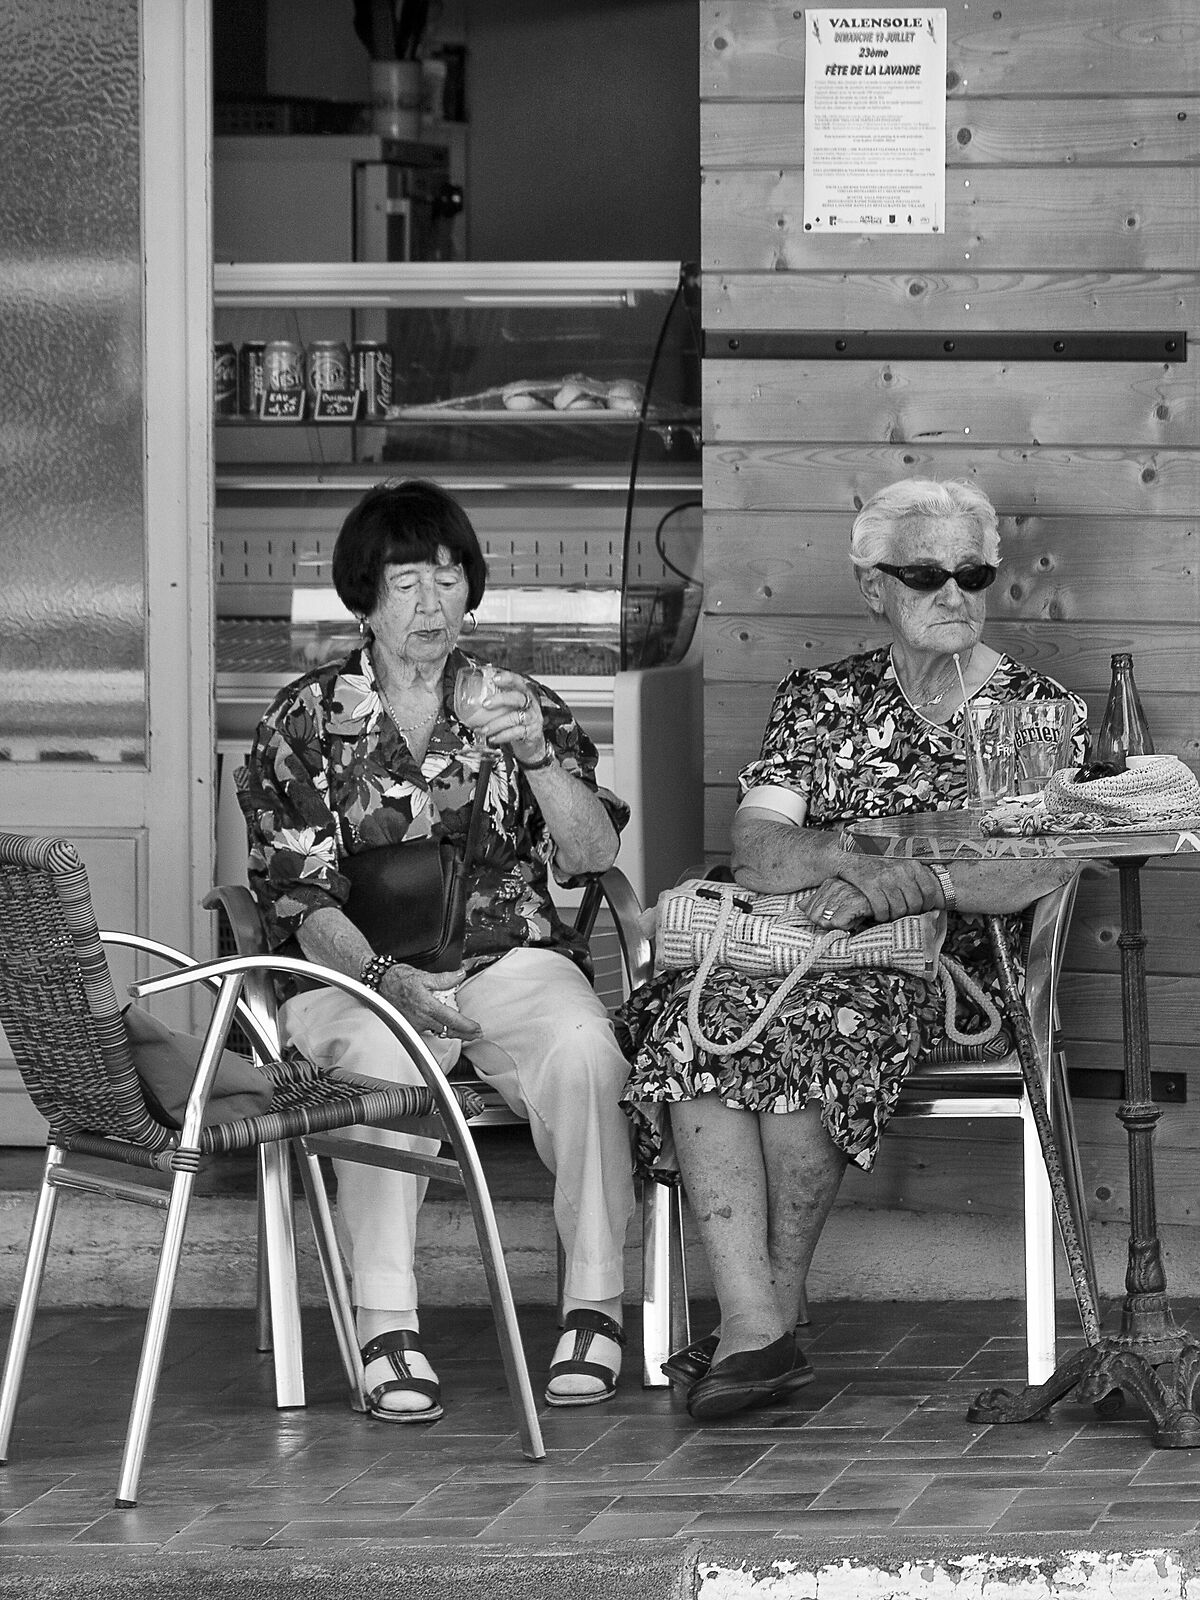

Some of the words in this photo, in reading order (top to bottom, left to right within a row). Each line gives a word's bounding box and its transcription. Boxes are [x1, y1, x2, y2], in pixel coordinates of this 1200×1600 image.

[829, 18, 923, 28] VALENSOLE
[834, 32, 874, 43] DIMANCHE
[876, 32, 884, 43] 19
[885, 32, 915, 43] JUILLET
[825, 63, 849, 76] FÊTE
[850, 65, 863, 76] DE
[865, 65, 876, 76] LA
[879, 65, 921, 76] LAVANDE
[1014, 722, 1060, 748] errier
